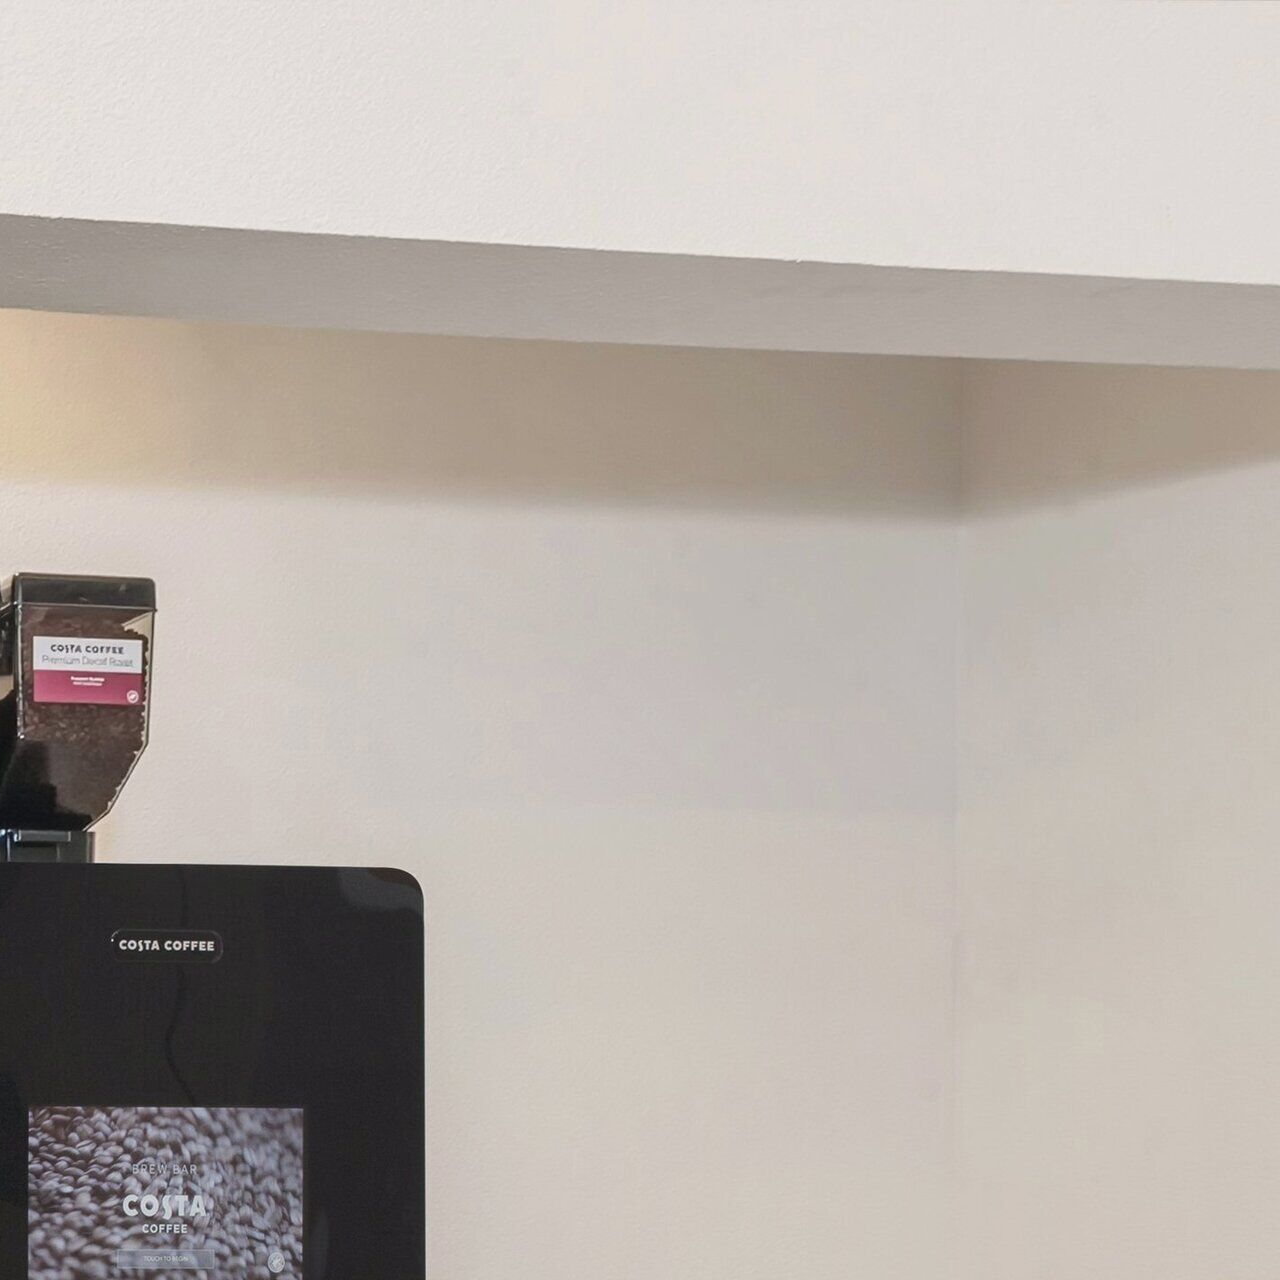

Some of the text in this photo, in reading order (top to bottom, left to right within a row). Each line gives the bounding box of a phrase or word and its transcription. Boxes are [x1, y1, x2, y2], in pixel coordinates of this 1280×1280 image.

[51, 644, 124, 654] COSTA COFFEE
[119, 940, 215, 951] COSTA COFFEE
[132, 1164, 197, 1174] BREW BAR
[123, 1194, 207, 1220] COSTA
[142, 1224, 188, 1233] COFFEE
